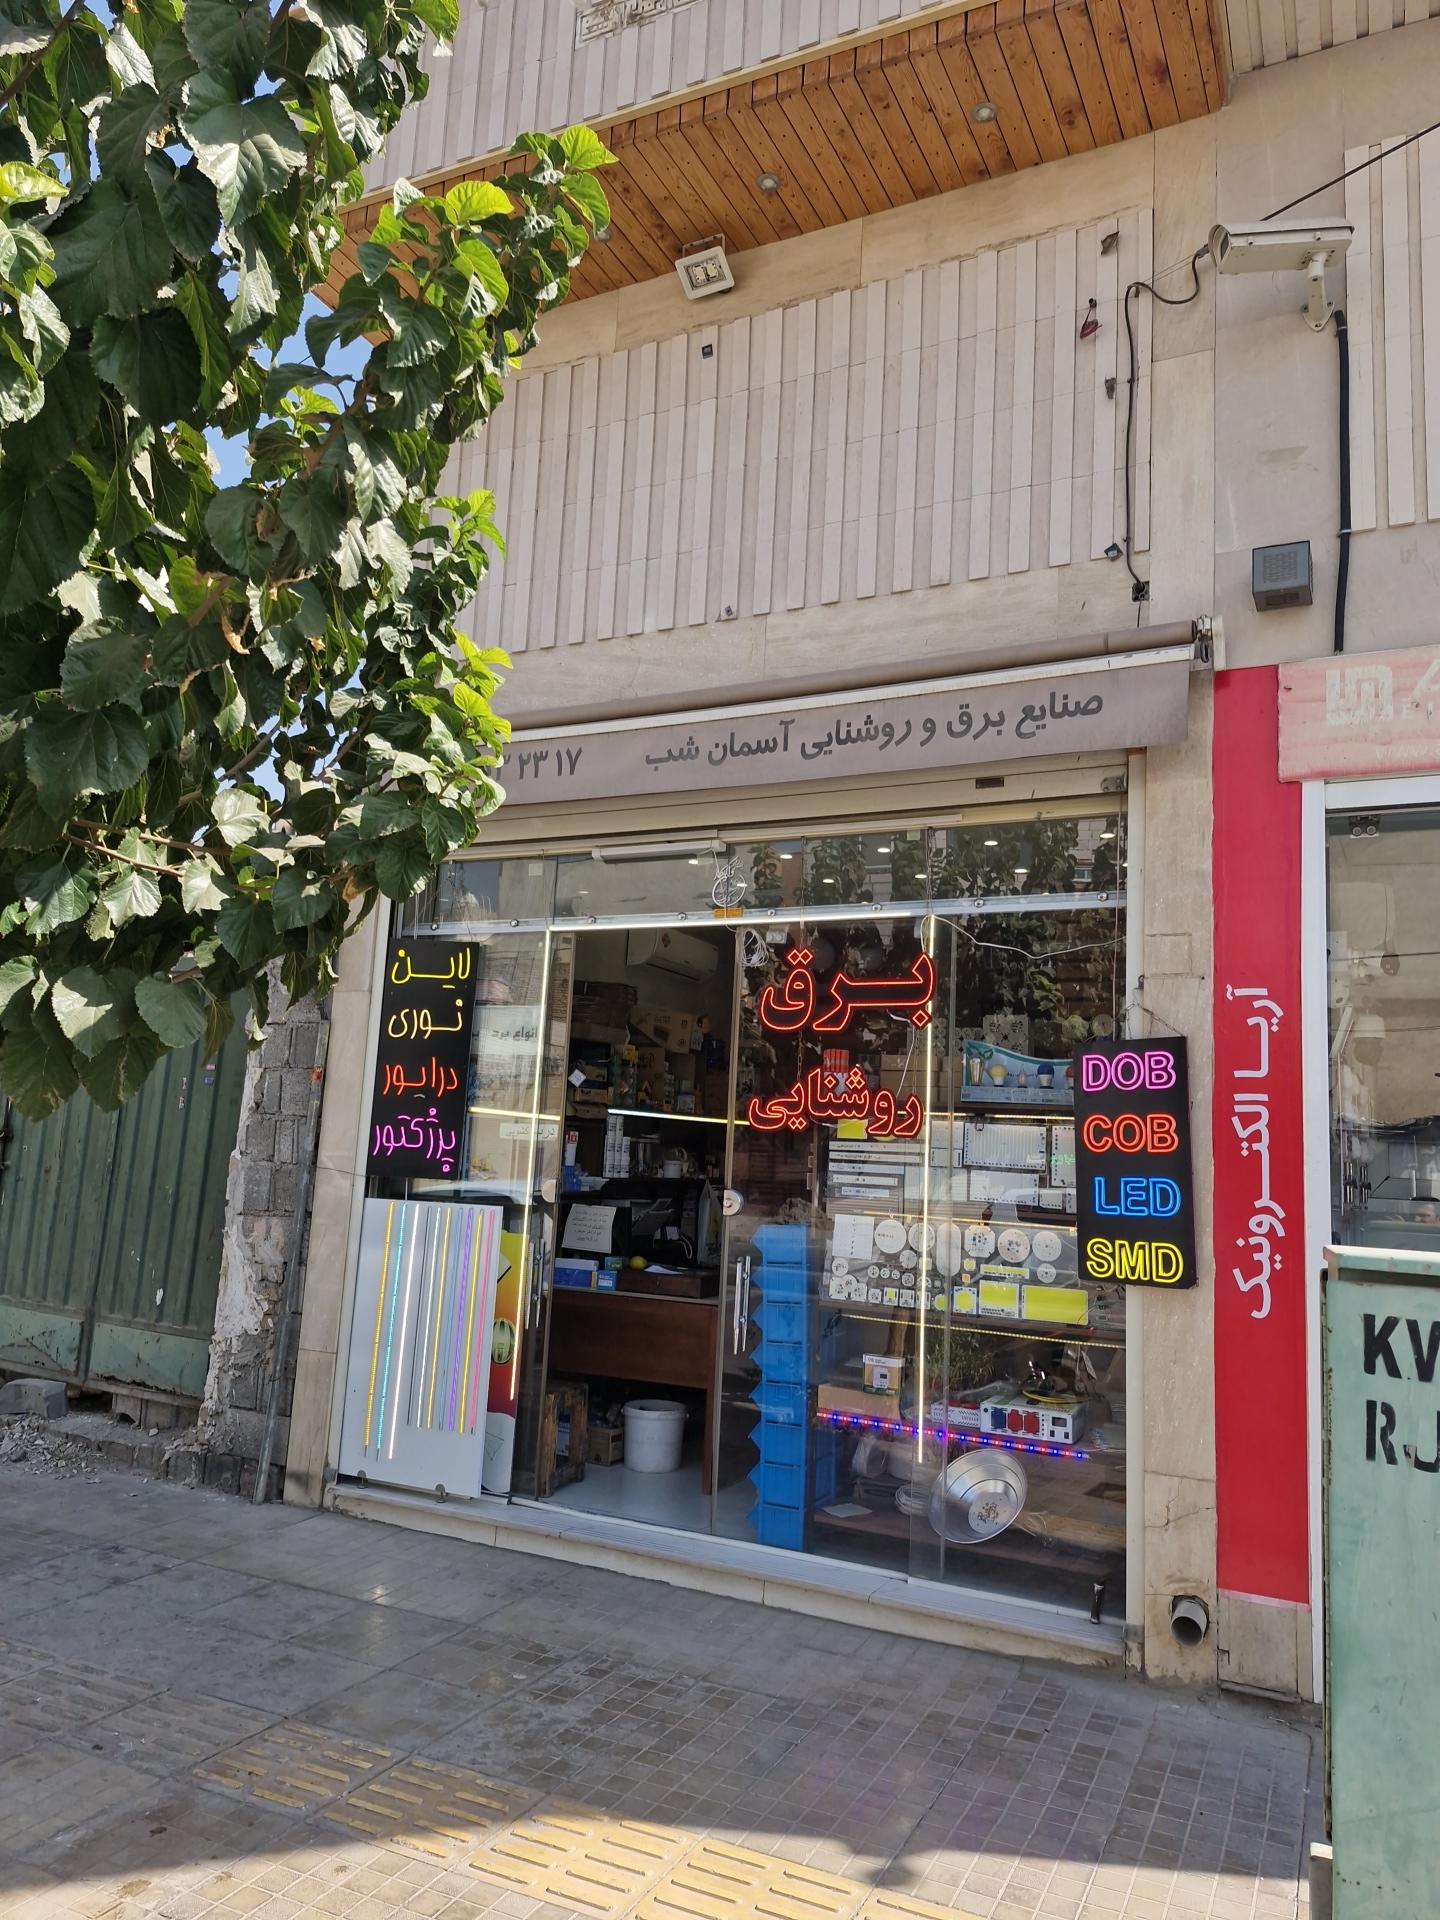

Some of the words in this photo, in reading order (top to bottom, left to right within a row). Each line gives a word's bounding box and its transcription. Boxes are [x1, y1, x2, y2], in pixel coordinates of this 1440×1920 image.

[920, 718, 937, 746] و
[946, 706, 1007, 740] برق
[1014, 688, 1104, 741] صنایع
[645, 734, 700, 771] شب
[707, 718, 794, 765] آسمان
[801, 714, 912, 761] روشنایی
[391, 947, 470, 989] لاین
[760, 948, 934, 1031] برق
[388, 999, 463, 1039] نوری
[1226, 984, 1284, 1078] آریا
[383, 1057, 457, 1098] درایور
[1081, 1051, 1176, 1092] DOB
[748, 1067, 922, 1136] روشنایی
[373, 1107, 456, 1172] پرژکتور
[1083, 1114, 1179, 1153] COB
[1095, 1177, 1182, 1217] LED
[1231, 1093, 1286, 1319] الکترونیک
[1086, 1238, 1184, 1284] SMD
